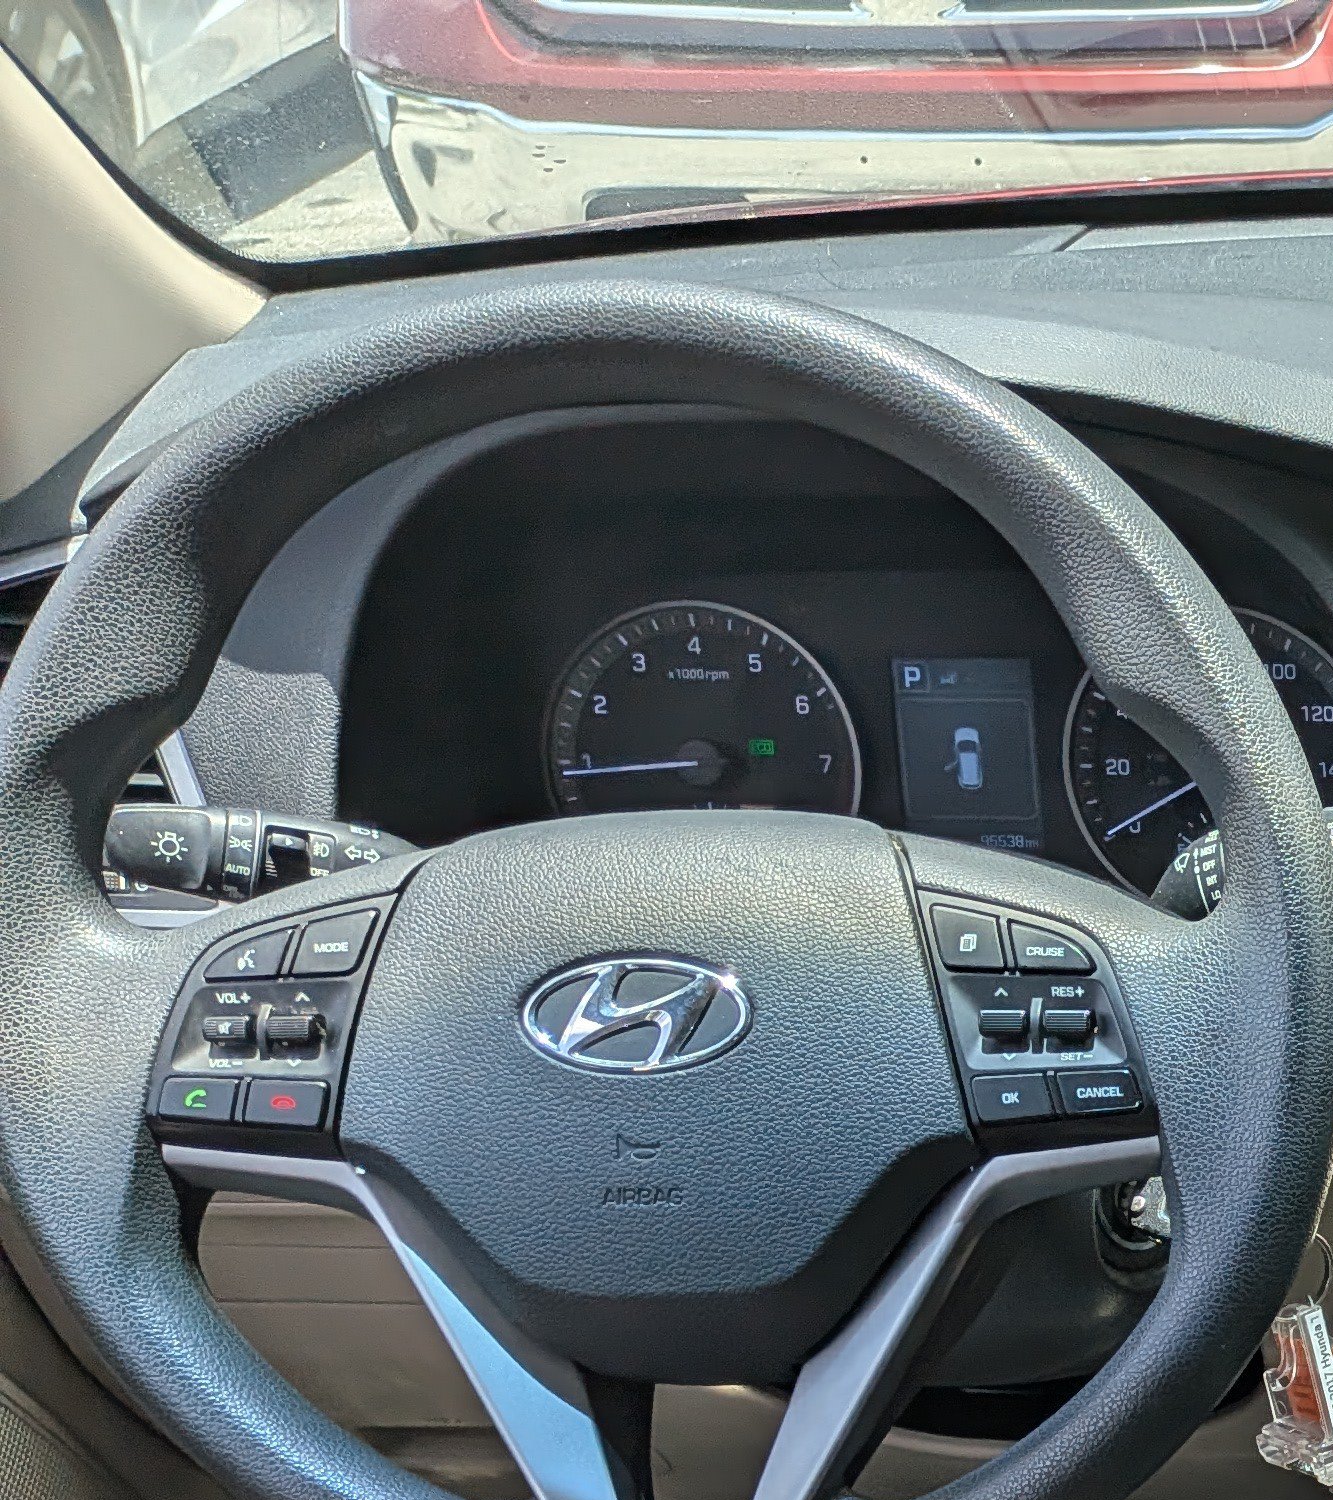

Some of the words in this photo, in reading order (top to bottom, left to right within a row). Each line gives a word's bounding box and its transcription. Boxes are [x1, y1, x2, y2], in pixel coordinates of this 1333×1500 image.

[687, 637, 701, 655] 4
[632, 654, 647, 672] 3
[748, 654, 762, 673] 5
[904, 666, 921, 688] P
[593, 695, 608, 715] 2
[795, 696, 810, 714] 6
[581, 753, 592, 770] 1
[819, 754, 832, 774] 7
[1105, 758, 1131, 776] 20
[225, 863, 251, 876] AUTO
[313, 942, 349, 953] MODE
[1026, 946, 1065, 957] CRUISE
[1001, 1092, 1020, 1104] OK
[1076, 1086, 1125, 1099] CANCEL
[602, 1187, 684, 1206] AIRBAG
